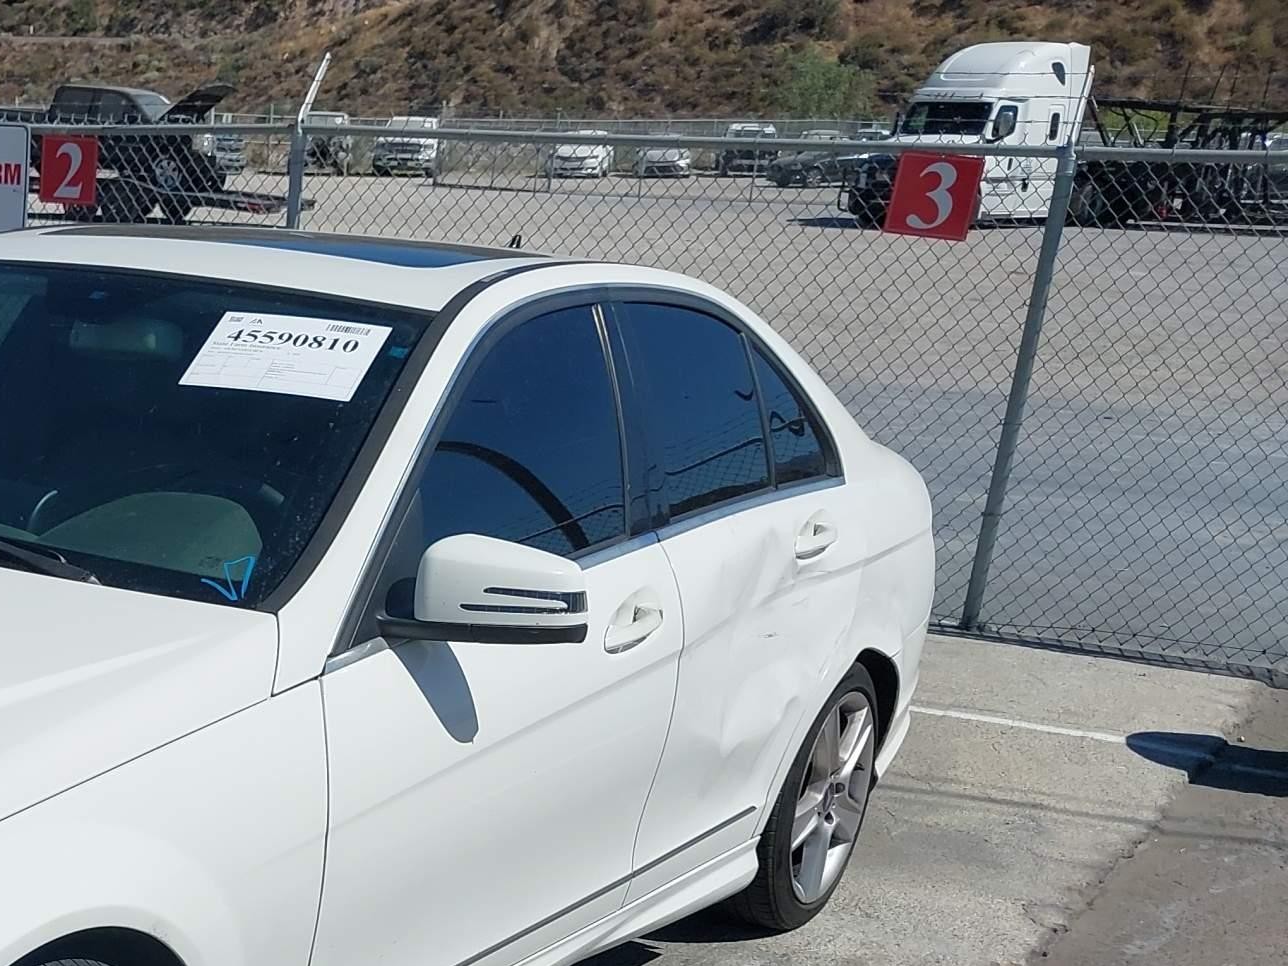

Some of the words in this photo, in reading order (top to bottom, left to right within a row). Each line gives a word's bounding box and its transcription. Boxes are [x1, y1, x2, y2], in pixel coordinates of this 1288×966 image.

[53, 142, 83, 200] 2
[906, 162, 957, 229] 3
[227, 328, 360, 353] 45590810
